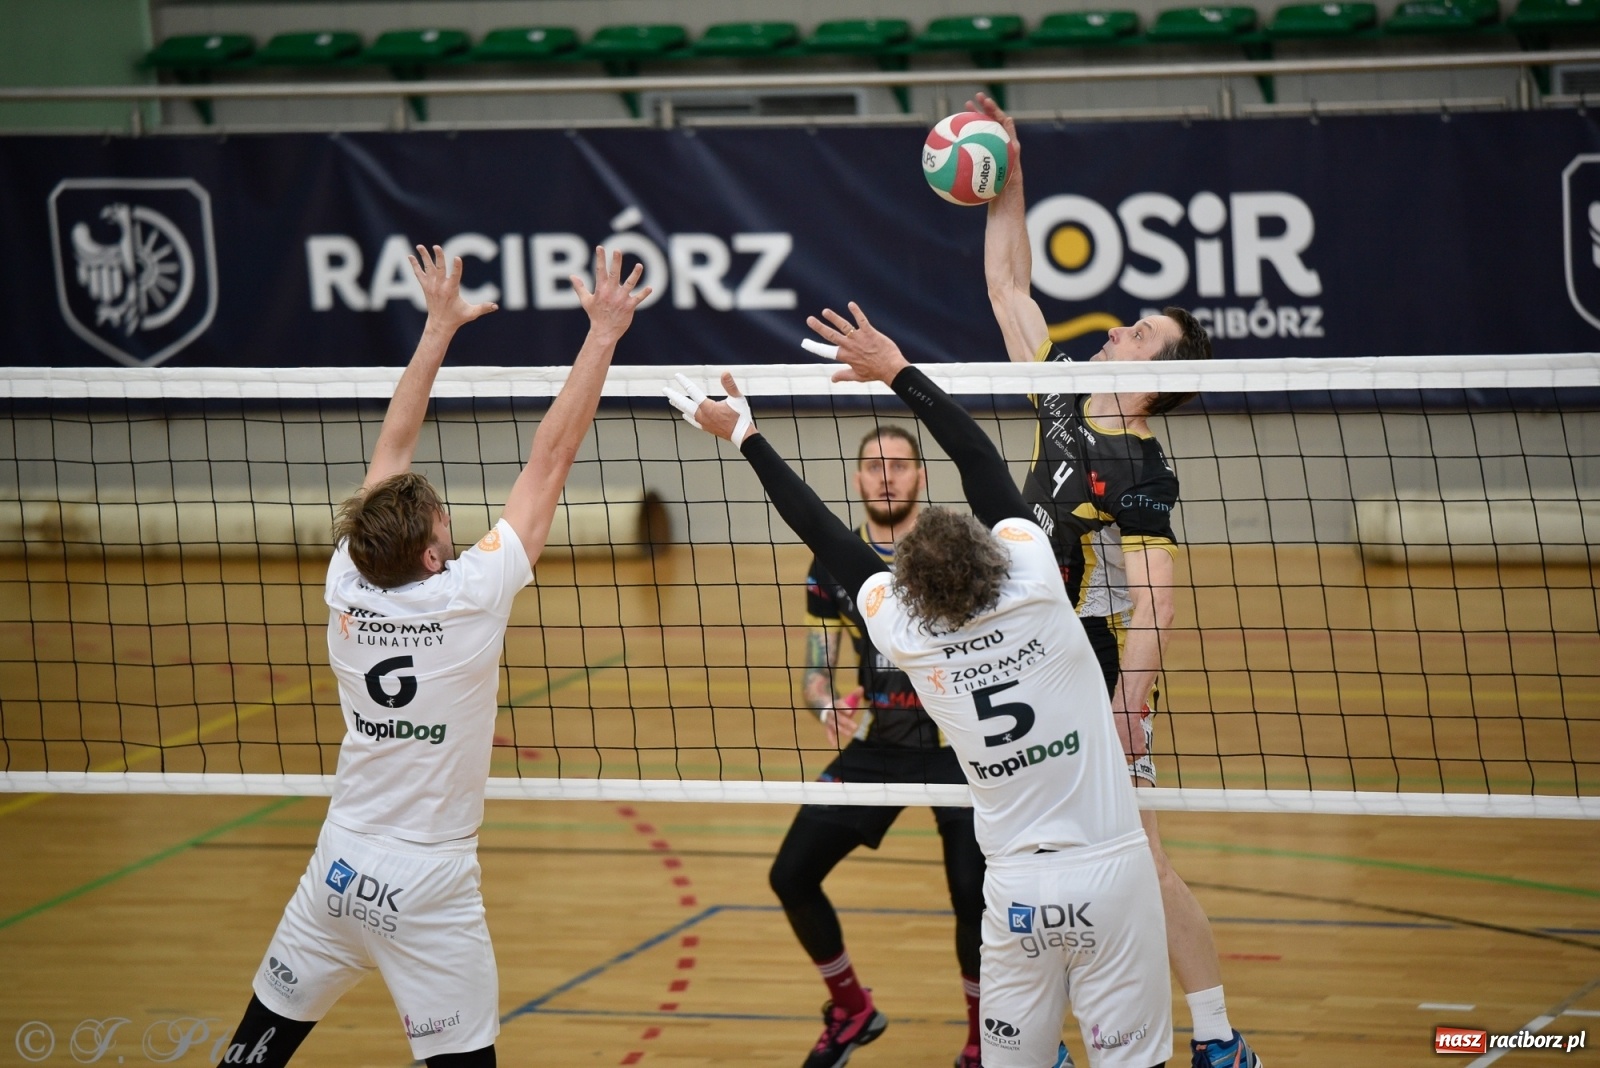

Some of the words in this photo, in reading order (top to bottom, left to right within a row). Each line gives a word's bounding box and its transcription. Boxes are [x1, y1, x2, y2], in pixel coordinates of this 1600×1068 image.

[977, 156, 991, 193] molten
[306, 206, 797, 311] RACIBÓRZ
[1140, 298, 1325, 338] CIBÓRZ
[1052, 460, 1074, 499] 4
[357, 620, 443, 635] ZOO-MAR
[357, 634, 444, 648] LUNATYCY
[942, 629, 1004, 659] PYCIU
[951, 638, 1042, 683] ZOO-MAR
[364, 655, 418, 709] 6
[353, 710, 447, 745] TropiDog
[971, 679, 1036, 748] 5
[968, 730, 1080, 780] TropiDog
[356, 874, 404, 913] DK
[326, 893, 399, 933] glass
[1040, 902, 1094, 929] DK
[1020, 928, 1097, 959] glass
[411, 1010, 460, 1034] kolgraf
[983, 1031, 1021, 1046] wepol
[1100, 1023, 1147, 1047] kolgraf
